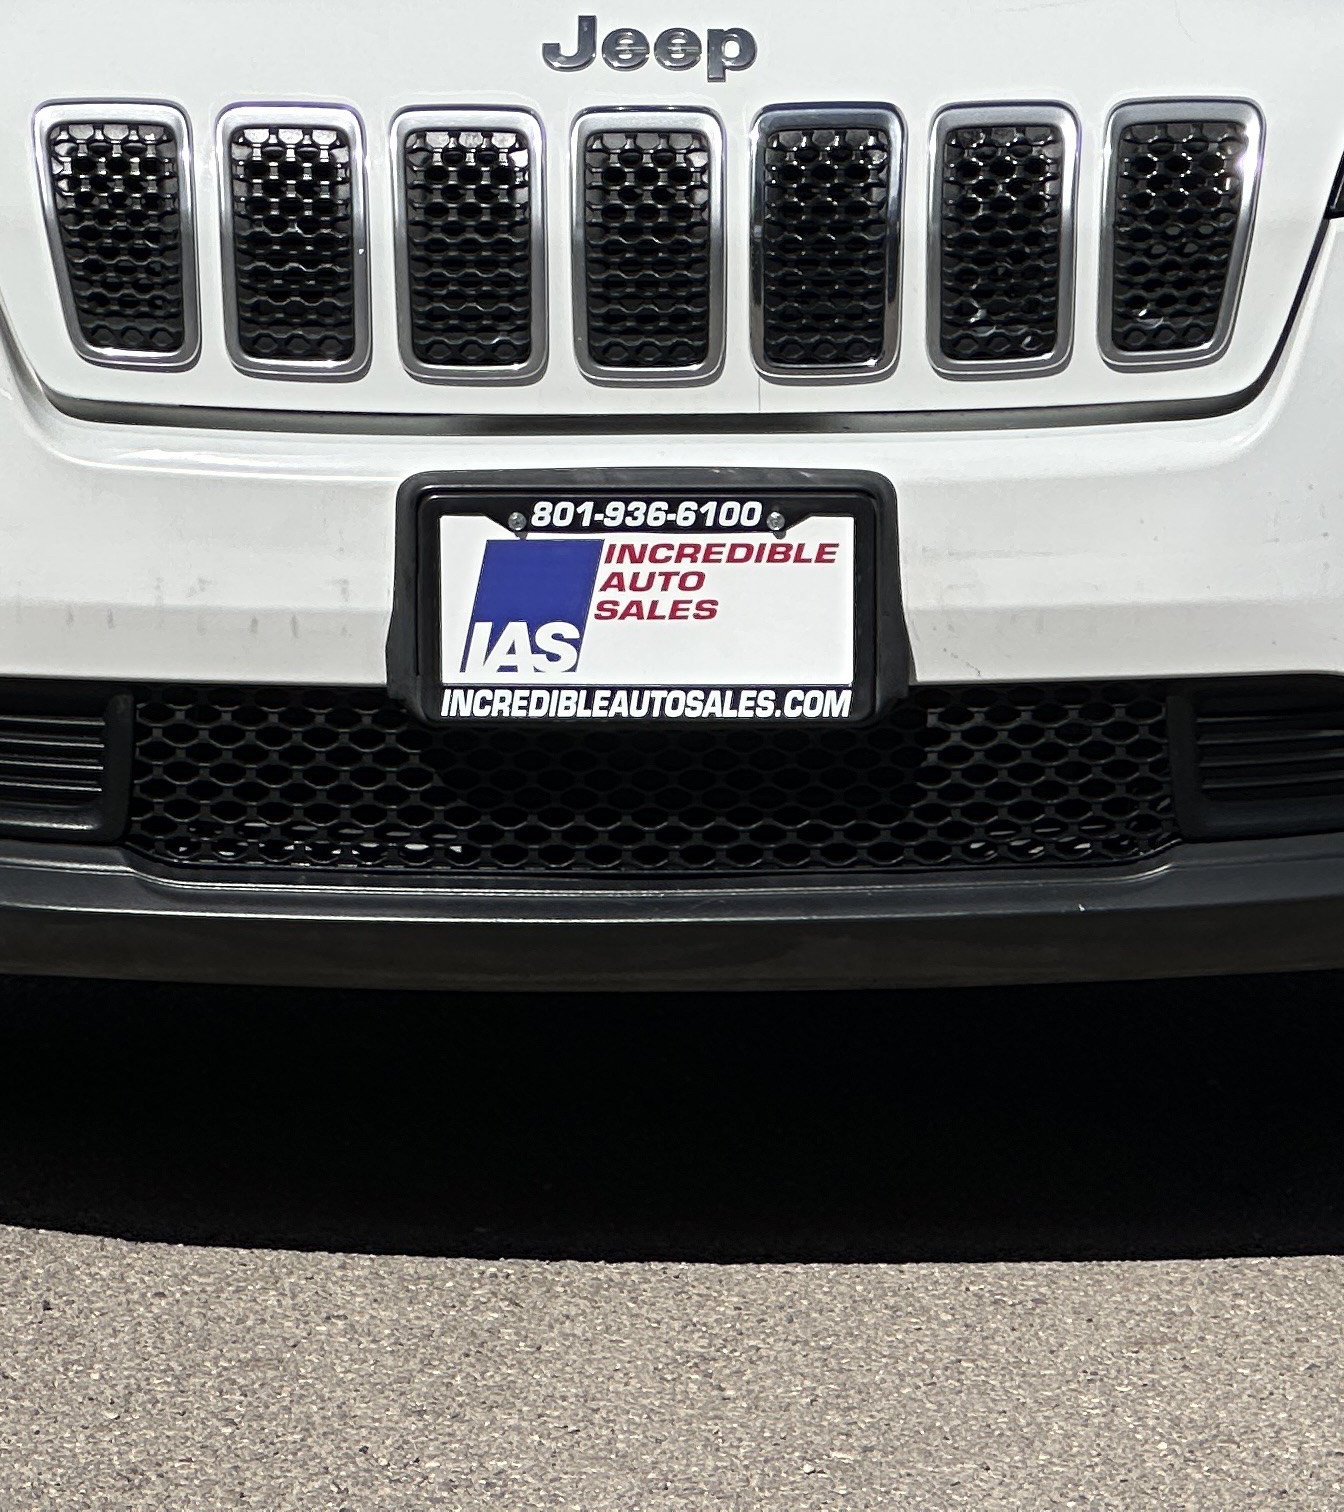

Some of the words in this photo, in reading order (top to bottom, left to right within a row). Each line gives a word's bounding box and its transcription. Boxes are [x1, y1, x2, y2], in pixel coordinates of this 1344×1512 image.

[542, 15, 758, 83] Jeep
[530, 500, 764, 528] 801-936-6100
[604, 542, 840, 565] INCREDIBLE
[599, 570, 706, 593] AUTO
[593, 599, 719, 621] SALES
[468, 619, 582, 674] IAS
[439, 688, 854, 719] INCREDIBLEAUTOSALES.COM
